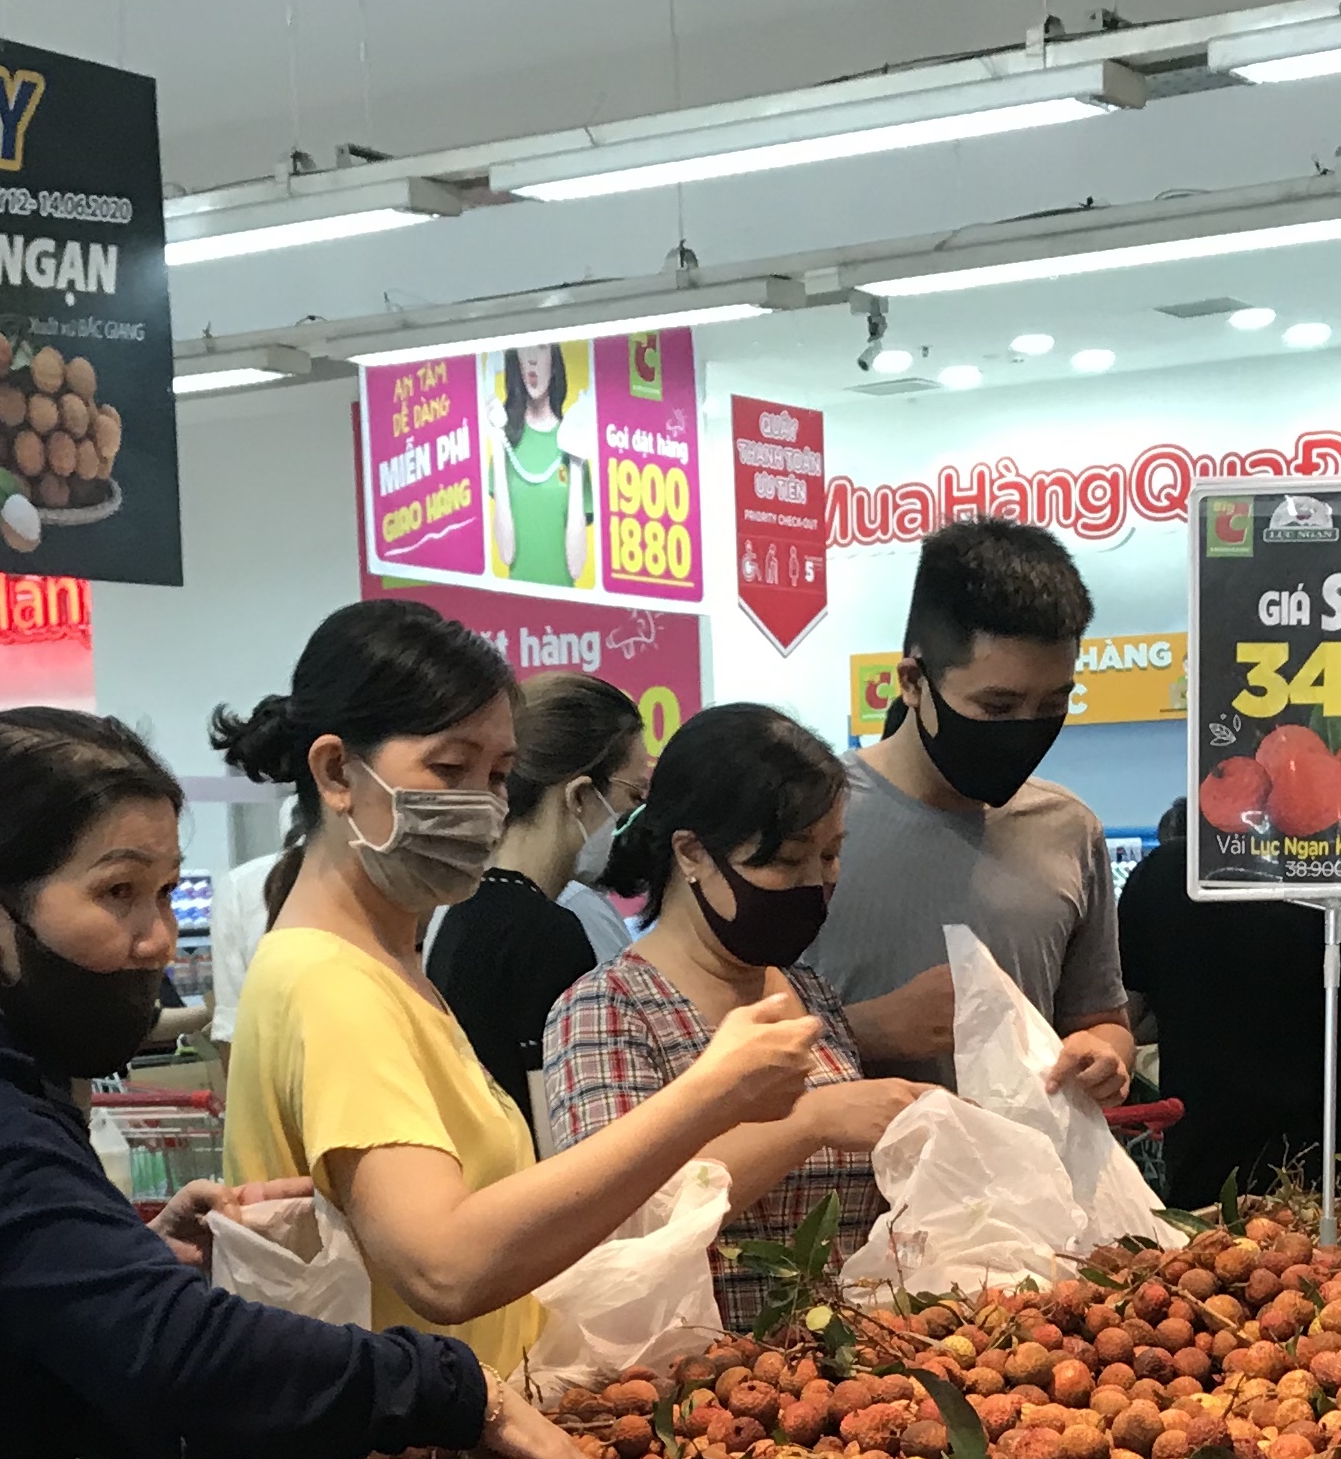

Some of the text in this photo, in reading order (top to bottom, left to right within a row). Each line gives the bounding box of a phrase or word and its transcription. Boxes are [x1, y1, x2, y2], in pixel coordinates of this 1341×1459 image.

[379, 417, 470, 496] MIỄN PHÍ
[606, 424, 689, 465] Gọi đặt hàng
[608, 458, 689, 522] 1900
[382, 502, 422, 542] GIAO
[610, 516, 691, 578] 1880
[1258, 583, 1311, 627] GIÁ
[520, 626, 601, 672] hàng
[1075, 639, 1172, 672] HÀNG
[1216, 834, 1246, 855] Vải
[1284, 837, 1329, 860] Ngạn
